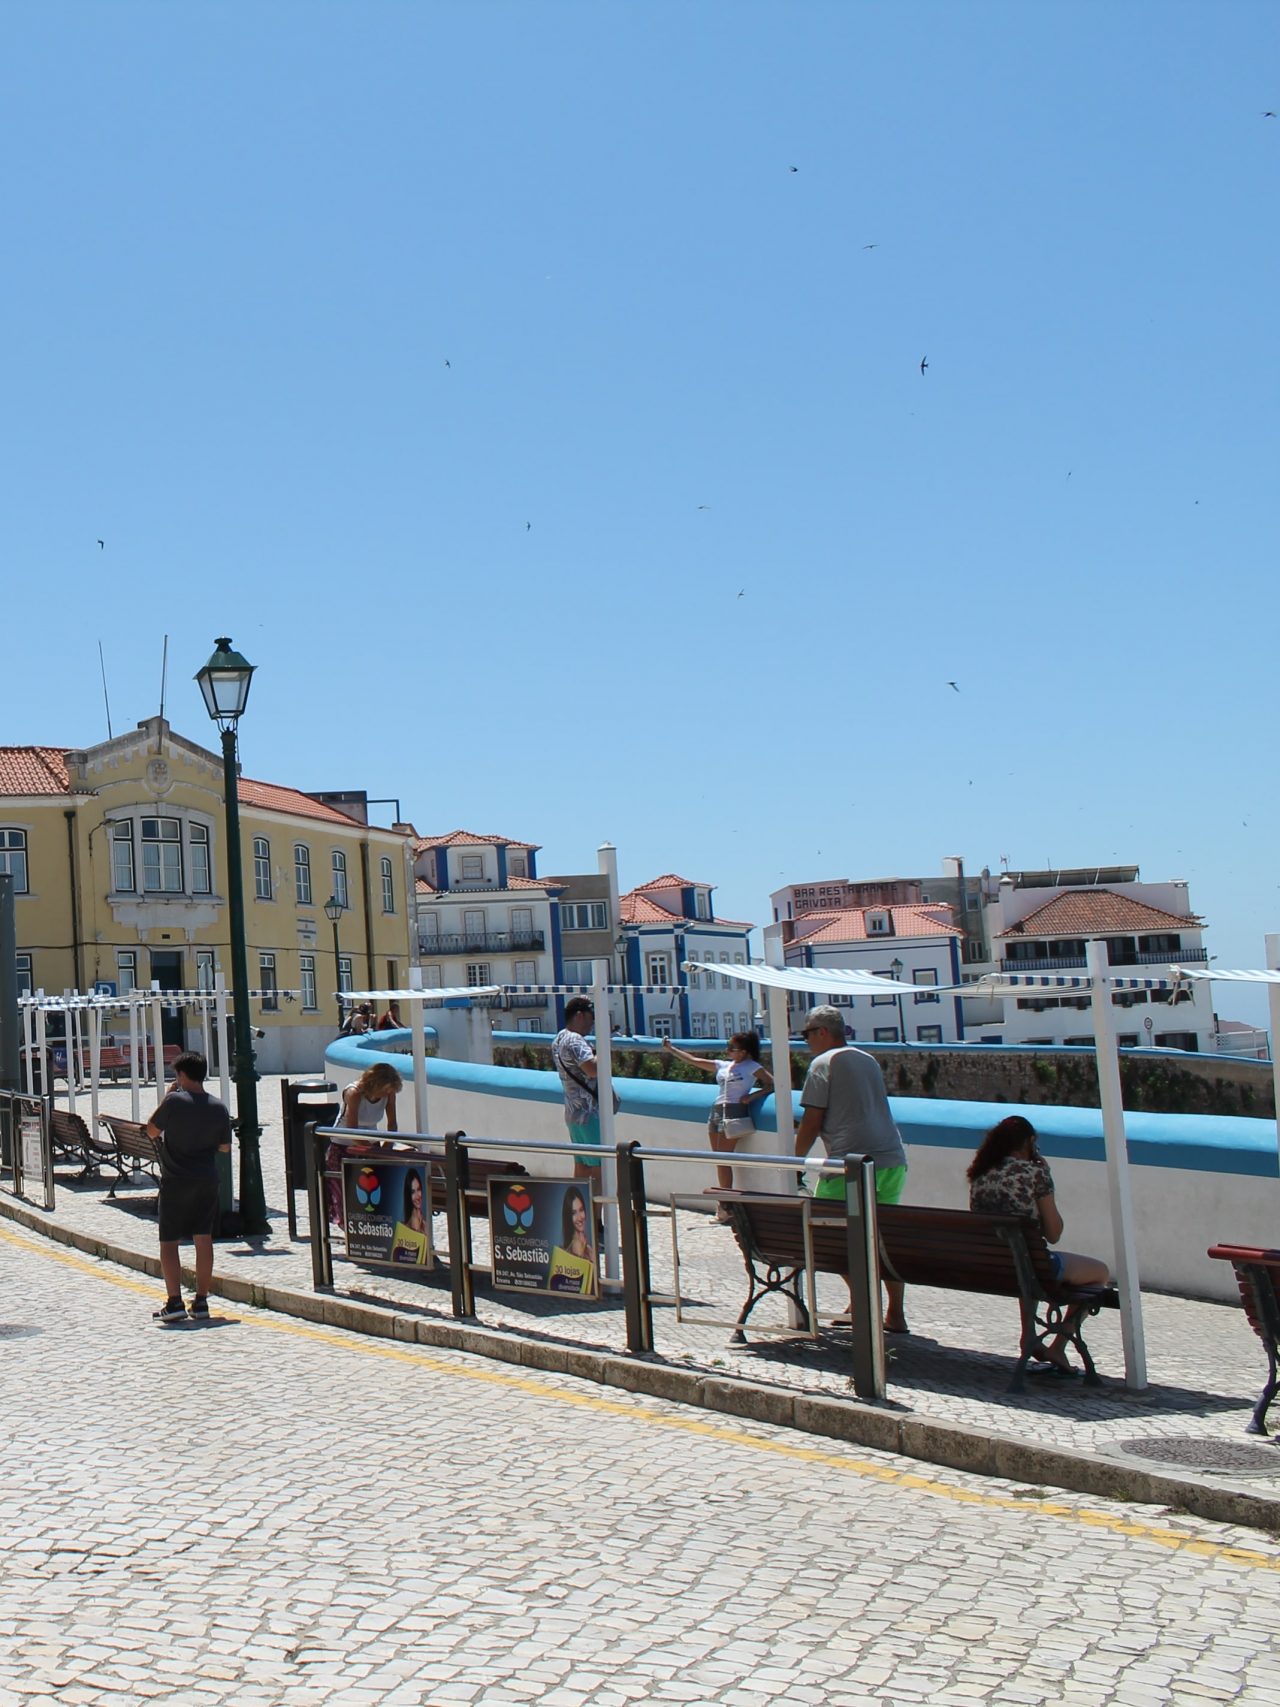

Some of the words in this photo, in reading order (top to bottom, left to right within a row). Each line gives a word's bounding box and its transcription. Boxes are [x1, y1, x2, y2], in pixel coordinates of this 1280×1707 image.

[794, 888, 815, 898] BAR
[795, 897, 841, 909] GAIVOTA
[348, 1220, 357, 1235] S.
[358, 1221, 394, 1238] Sebastião
[495, 1244, 505, 1260] S.
[505, 1245, 550, 1265] Sebastião
[564, 1265, 580, 1277] lojas
